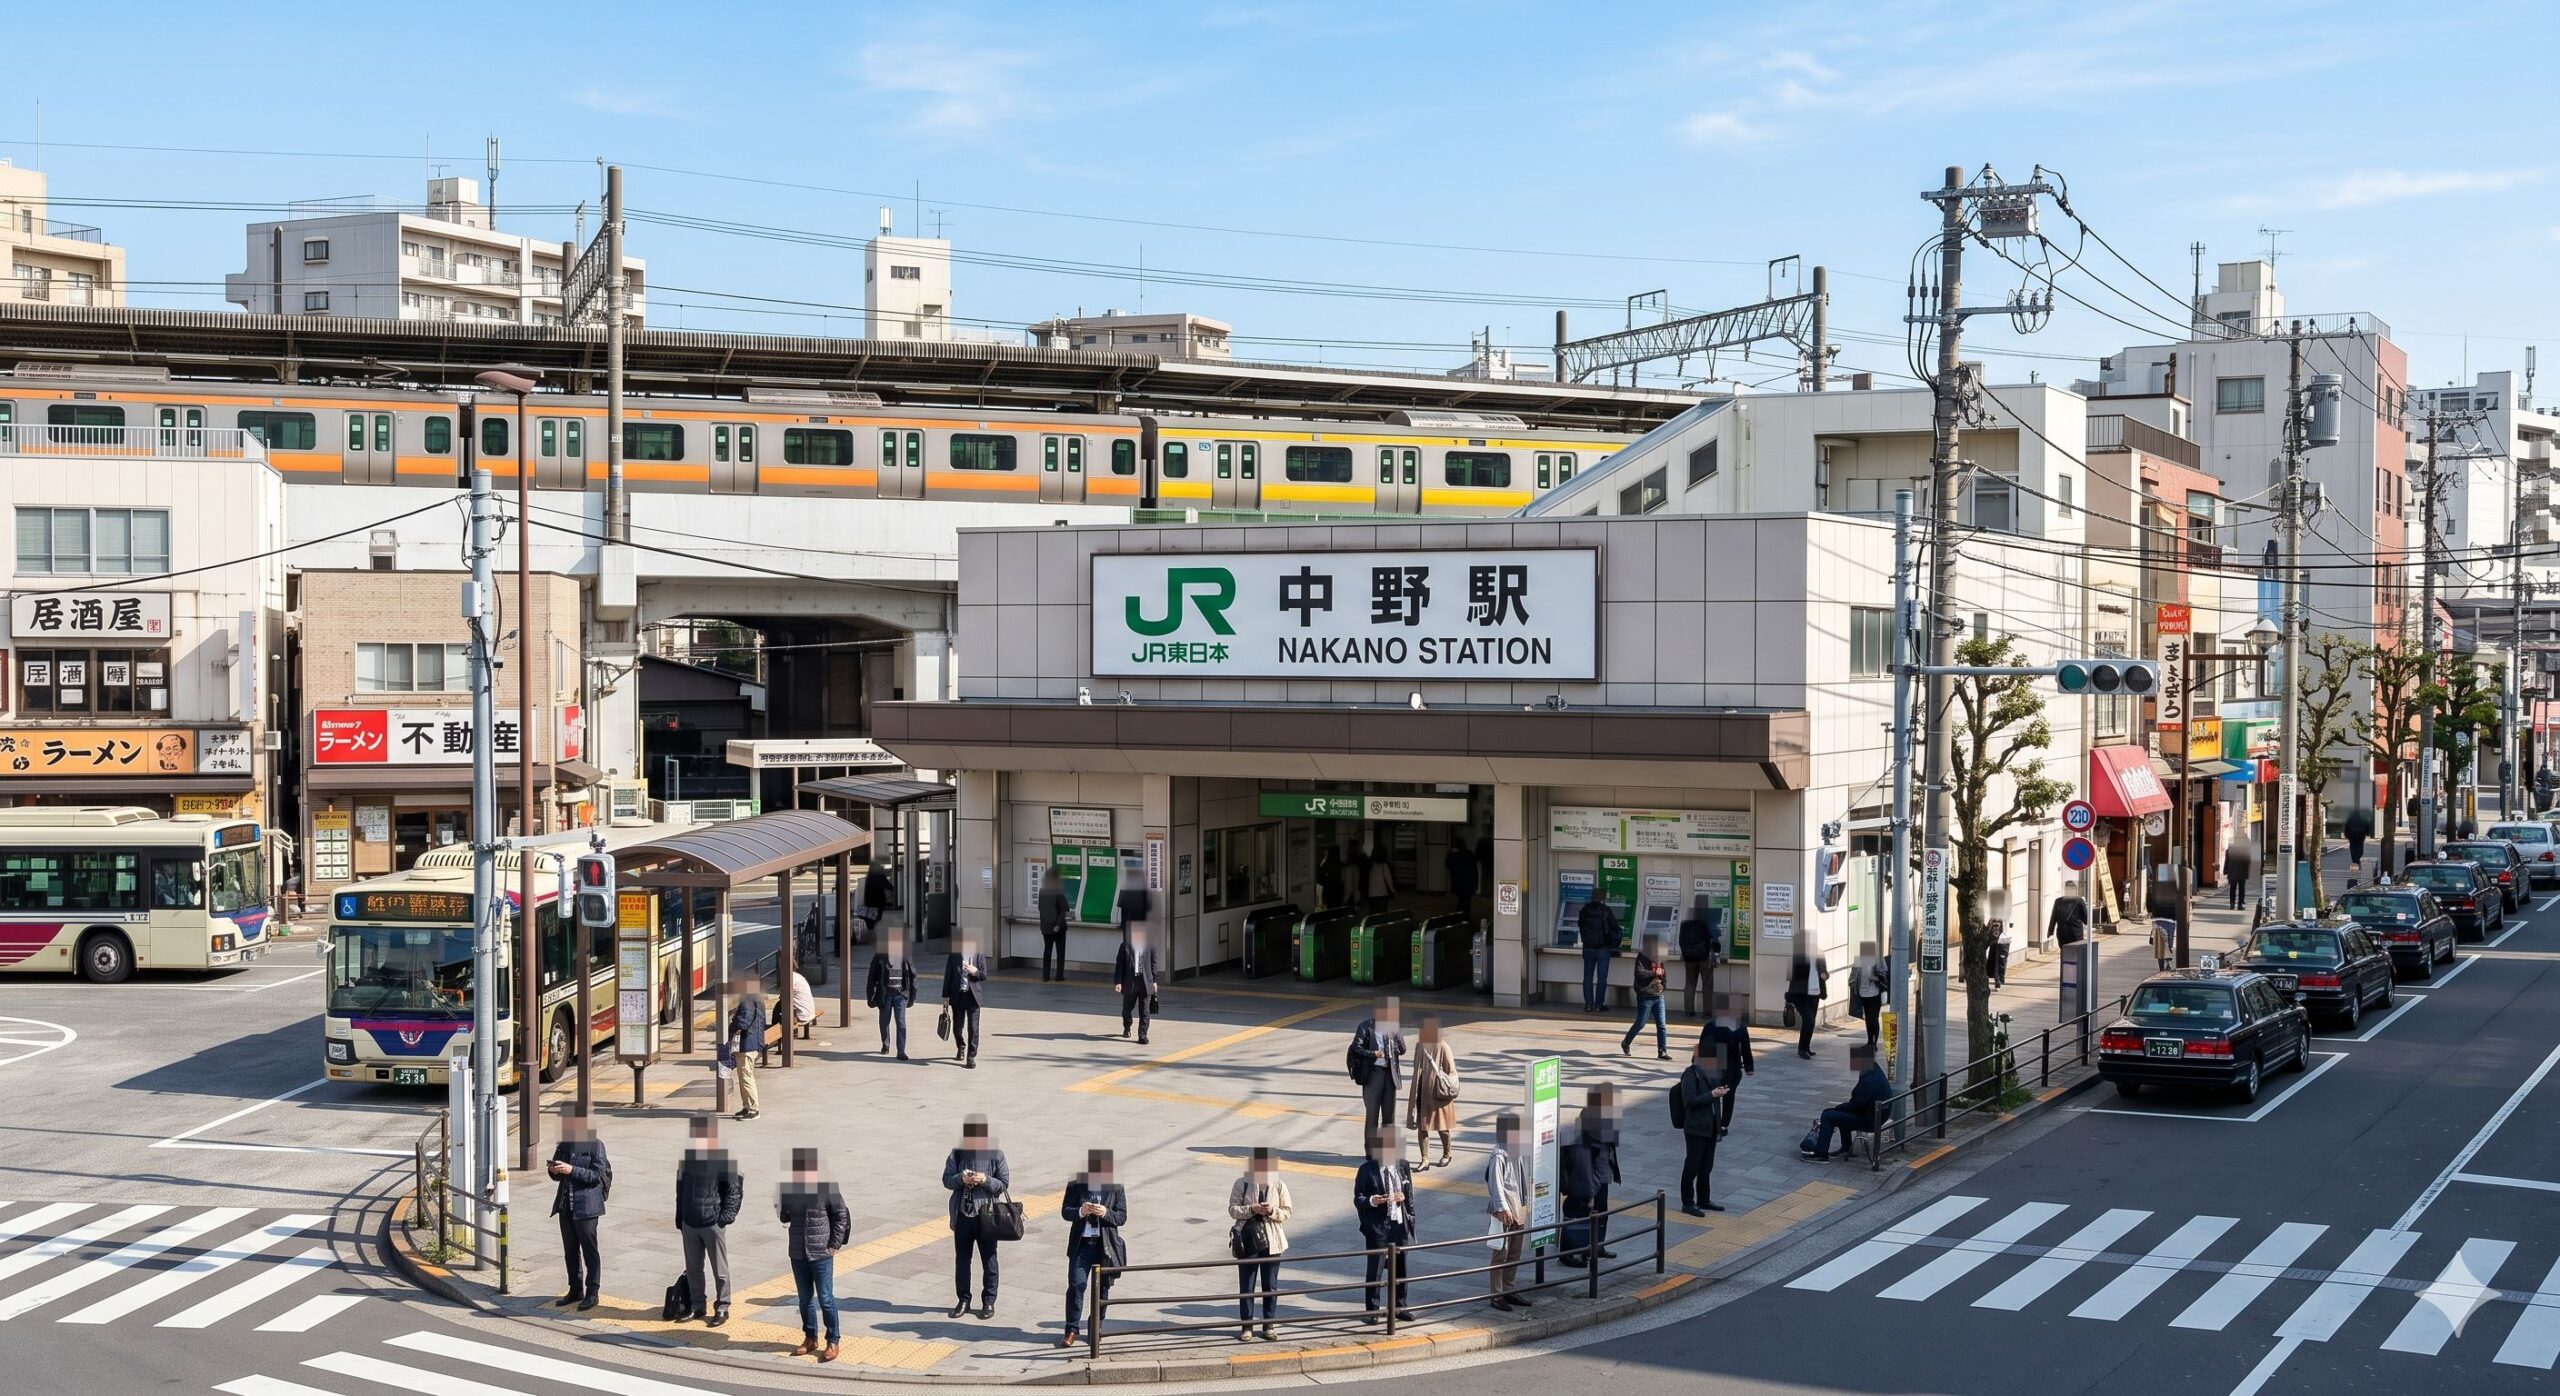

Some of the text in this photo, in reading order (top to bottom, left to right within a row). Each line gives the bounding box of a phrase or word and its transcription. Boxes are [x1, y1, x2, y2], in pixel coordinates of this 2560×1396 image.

[1125, 567, 1237, 636] JR
[1279, 566, 1530, 627] 中野駅
[29, 597, 144, 631] 居酒屋
[1131, 642, 1229, 664] JR東日本
[1278, 637, 1551, 665] NAKANO STATION
[42, 740, 143, 766] ラーメン
[319, 731, 384, 752] ラーメン
[401, 721, 520, 755] 不動産
